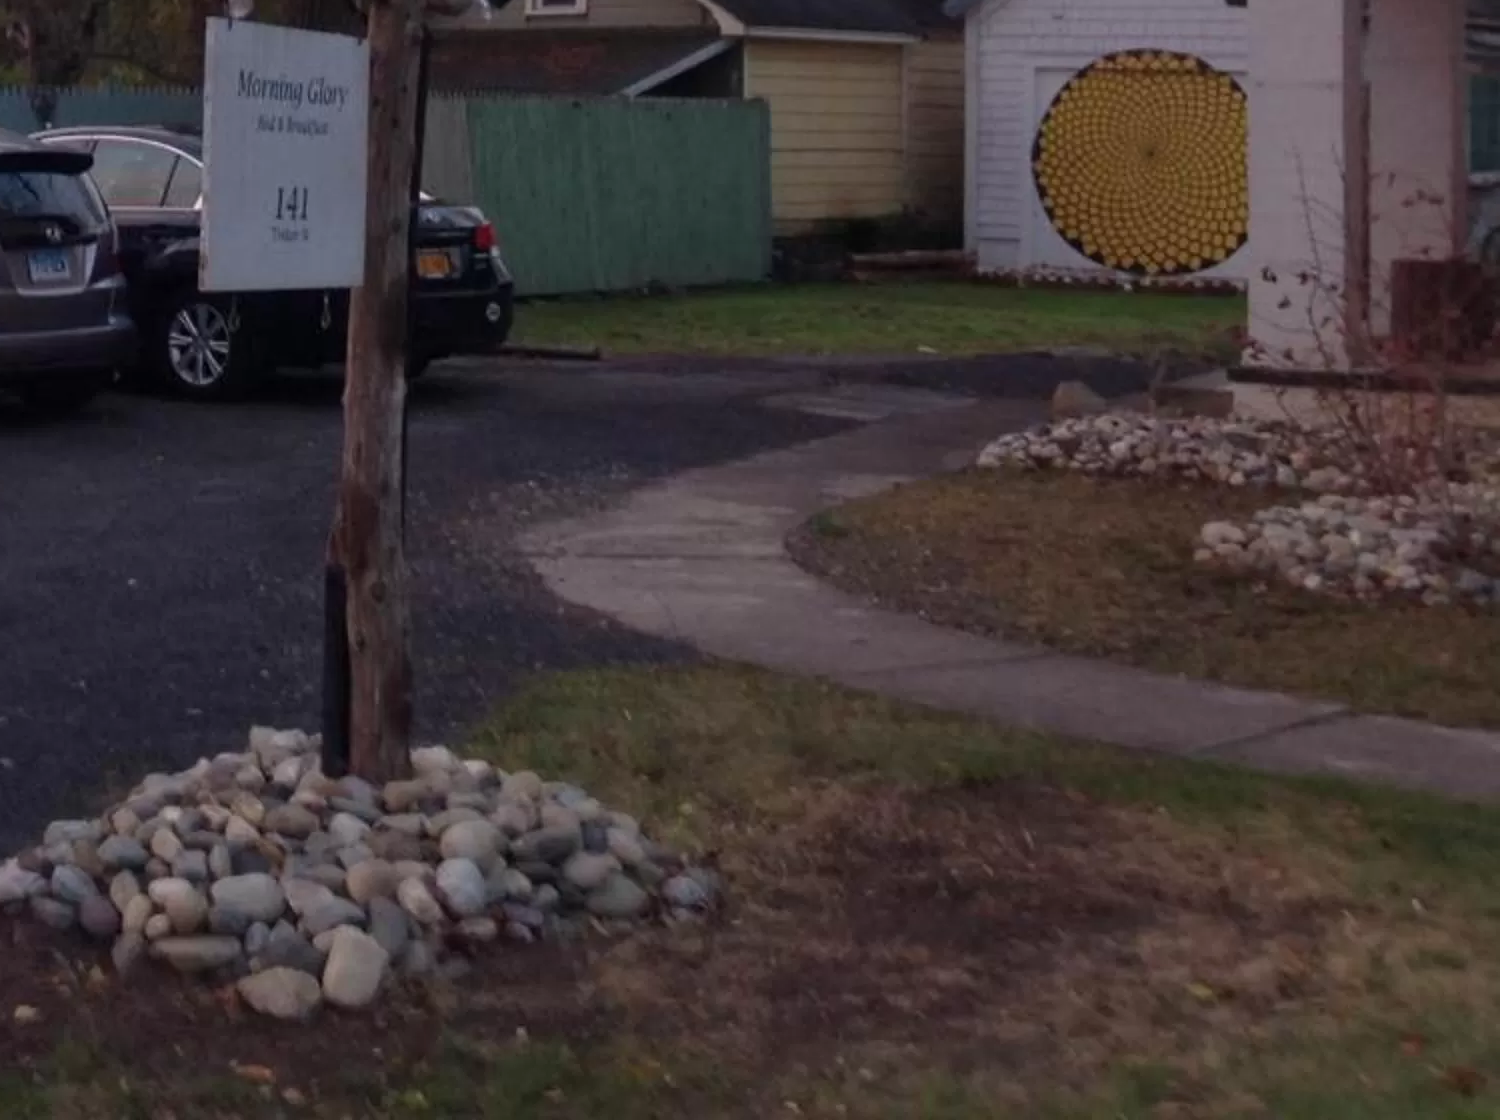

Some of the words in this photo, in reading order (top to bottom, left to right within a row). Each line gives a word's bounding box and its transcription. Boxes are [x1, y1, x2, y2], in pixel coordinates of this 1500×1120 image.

[237, 68, 303, 110] Morning
[307, 76, 349, 112] Glory
[275, 186, 308, 221] 141
